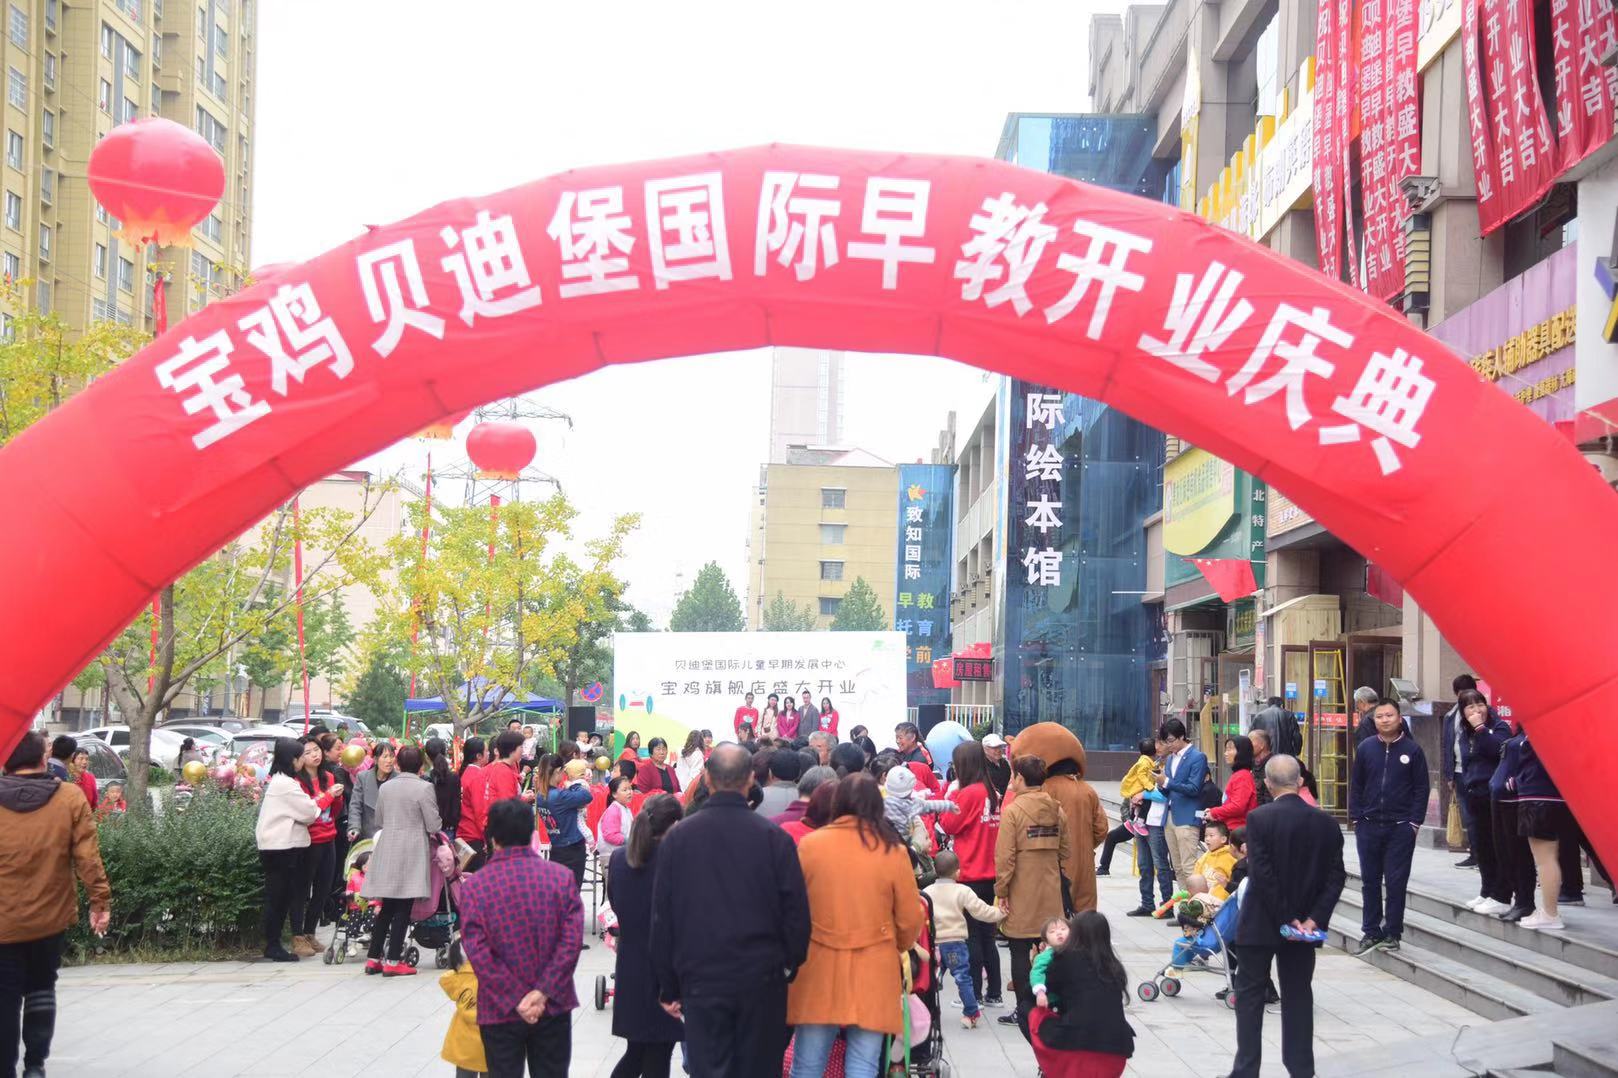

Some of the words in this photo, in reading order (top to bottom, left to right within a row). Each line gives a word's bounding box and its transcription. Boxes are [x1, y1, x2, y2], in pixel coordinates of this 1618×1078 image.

[154, 170, 1438, 476] 宝鸡贝迪堡国际早教开业庆典
[1024, 393, 1065, 587] 际绘本馆
[904, 506, 923, 580] 致知国际
[897, 592, 934, 610] 早教
[660, 679, 857, 697] 宝鸡旗舰店盛大开业
[674, 658, 847, 672] 贝迪堡国际儿童早期发展中心
